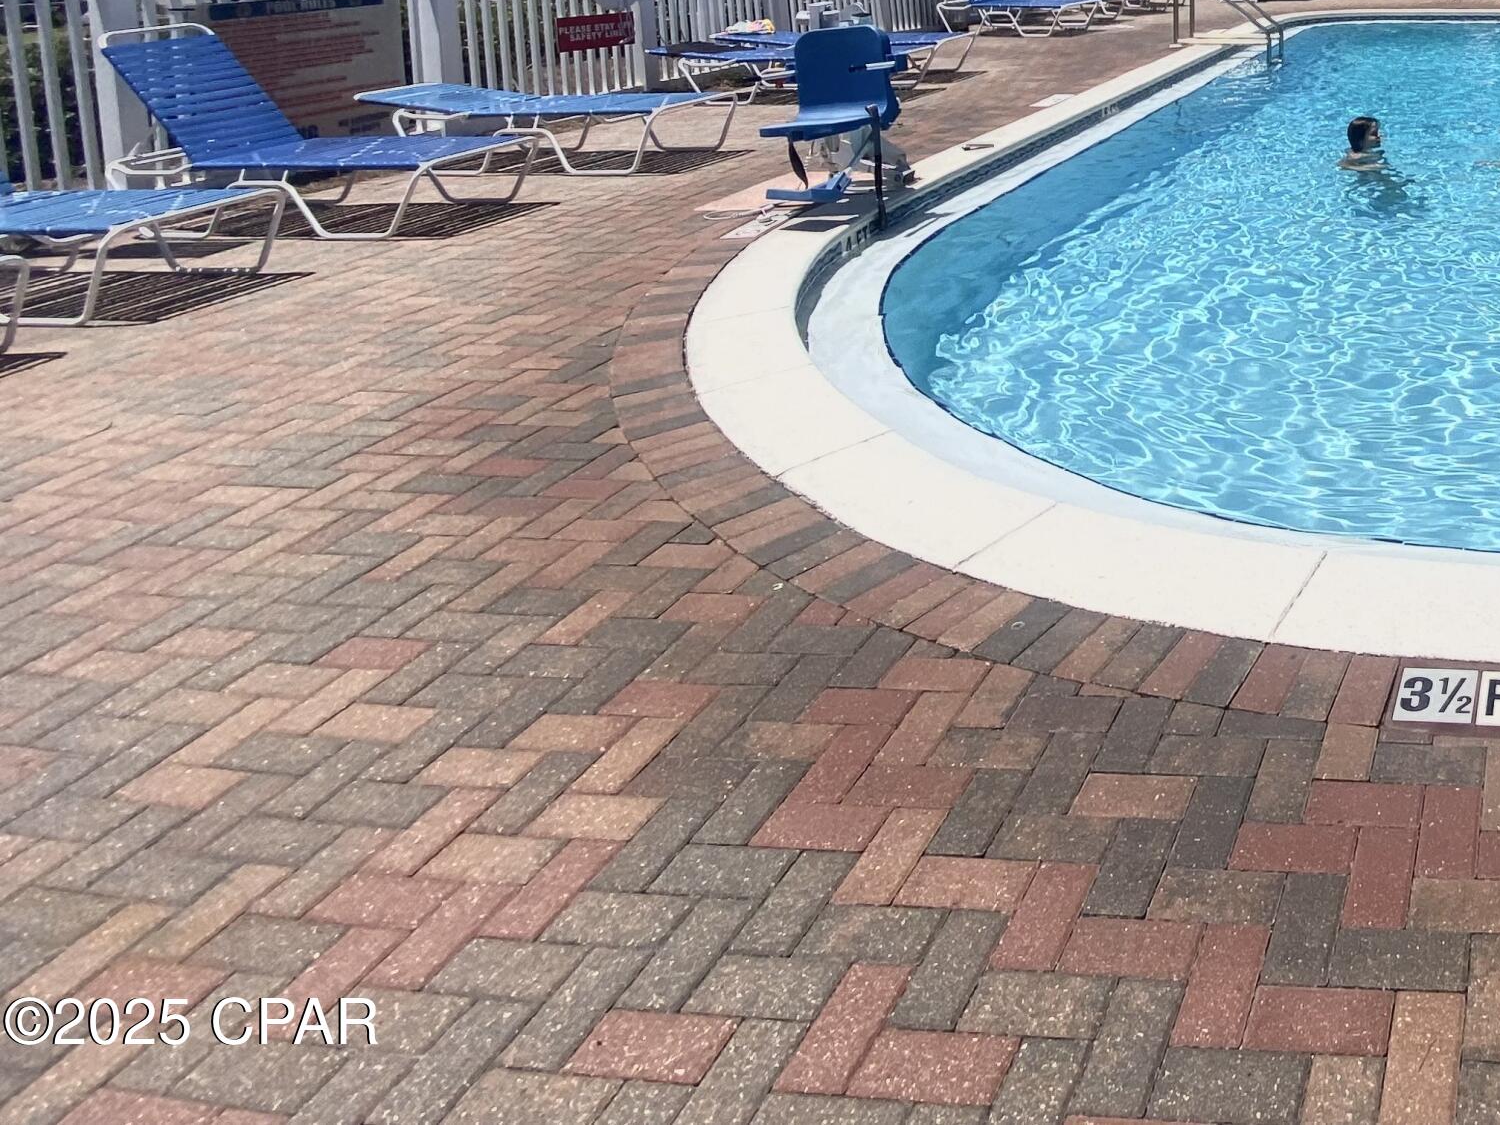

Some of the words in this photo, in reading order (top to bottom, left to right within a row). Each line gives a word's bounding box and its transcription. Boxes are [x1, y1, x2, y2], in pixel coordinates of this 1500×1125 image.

[559, 24, 591, 35] PLEASE
[594, 22, 615, 31] STAY
[570, 31, 602, 42] SAFETY
